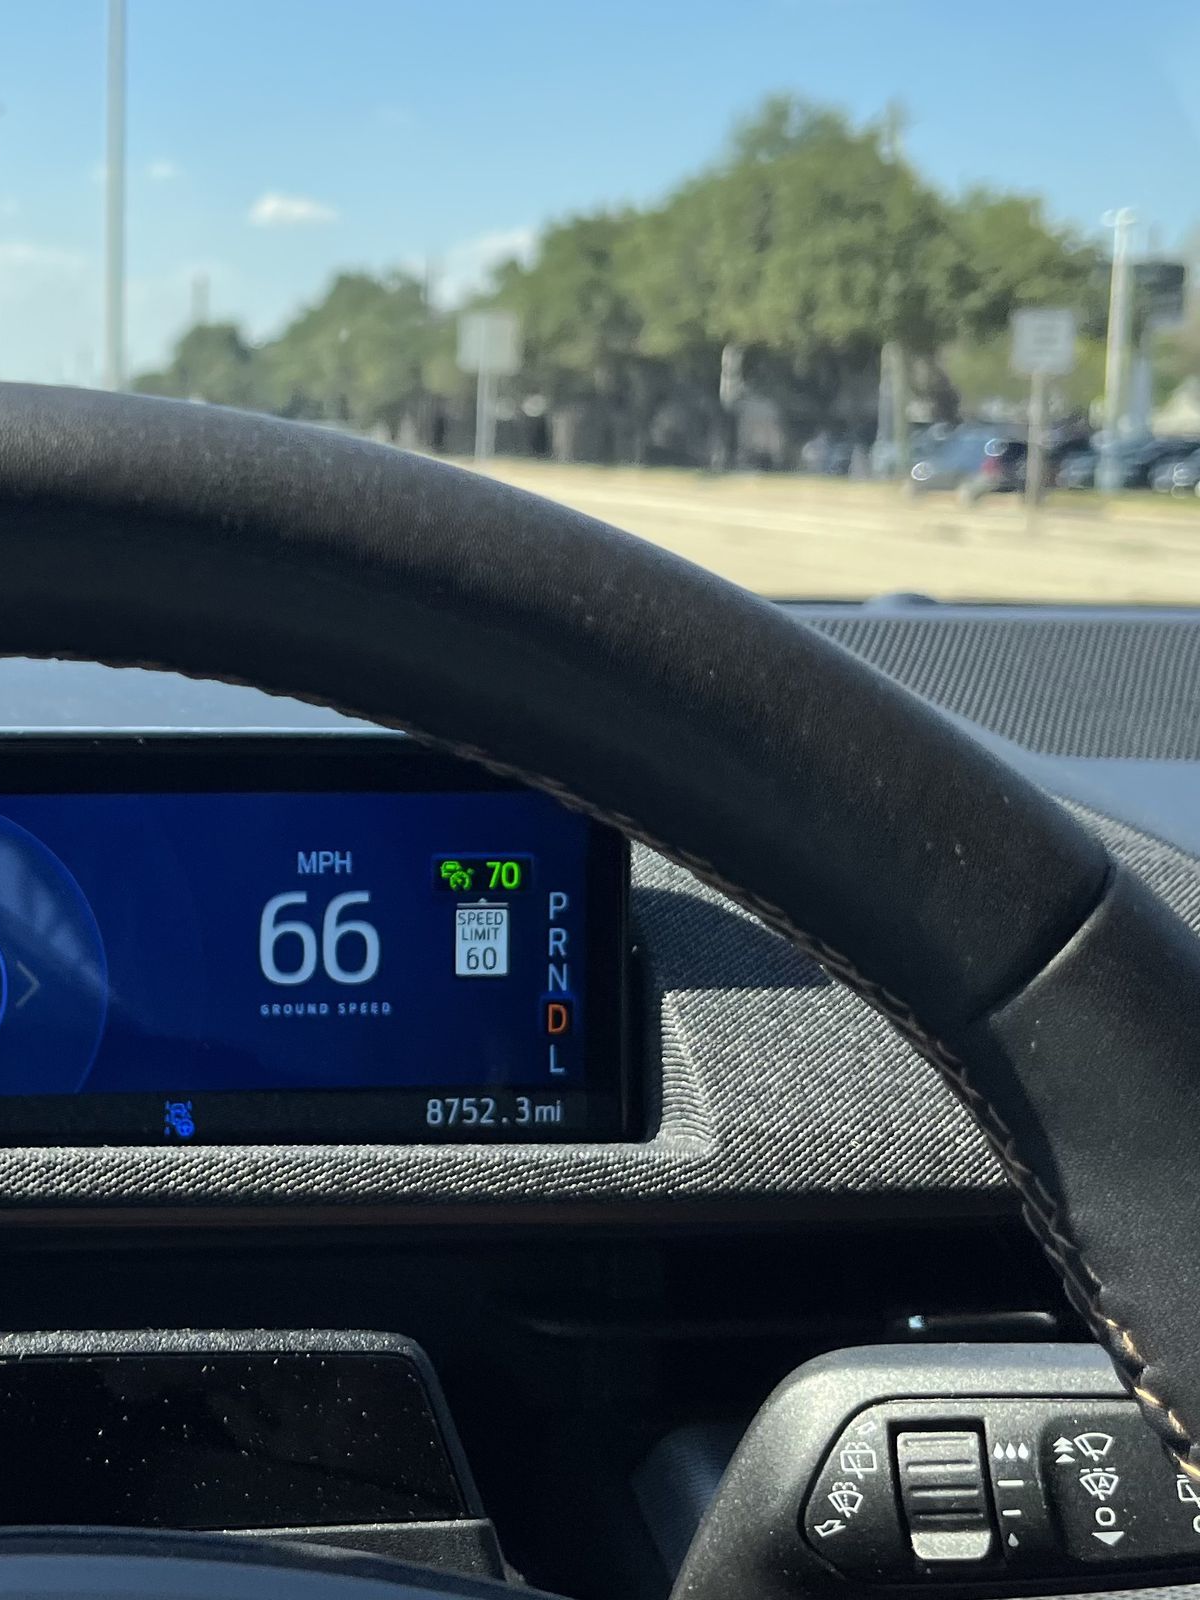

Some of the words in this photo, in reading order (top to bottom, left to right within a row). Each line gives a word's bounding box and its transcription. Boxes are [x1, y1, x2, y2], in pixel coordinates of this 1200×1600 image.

[297, 851, 353, 874] MPH
[486, 861, 521, 890] 70
[457, 911, 504, 926] SPEED
[549, 891, 567, 921] P
[259, 890, 380, 985] 66
[461, 926, 500, 941] LIMIT
[549, 927, 568, 957] R
[466, 946, 497, 971] 60
[548, 962, 567, 992] N
[260, 1003, 329, 1015] GROUND
[338, 1001, 392, 1015] SPEED
[548, 1003, 568, 1033] D
[550, 1044, 565, 1073] L
